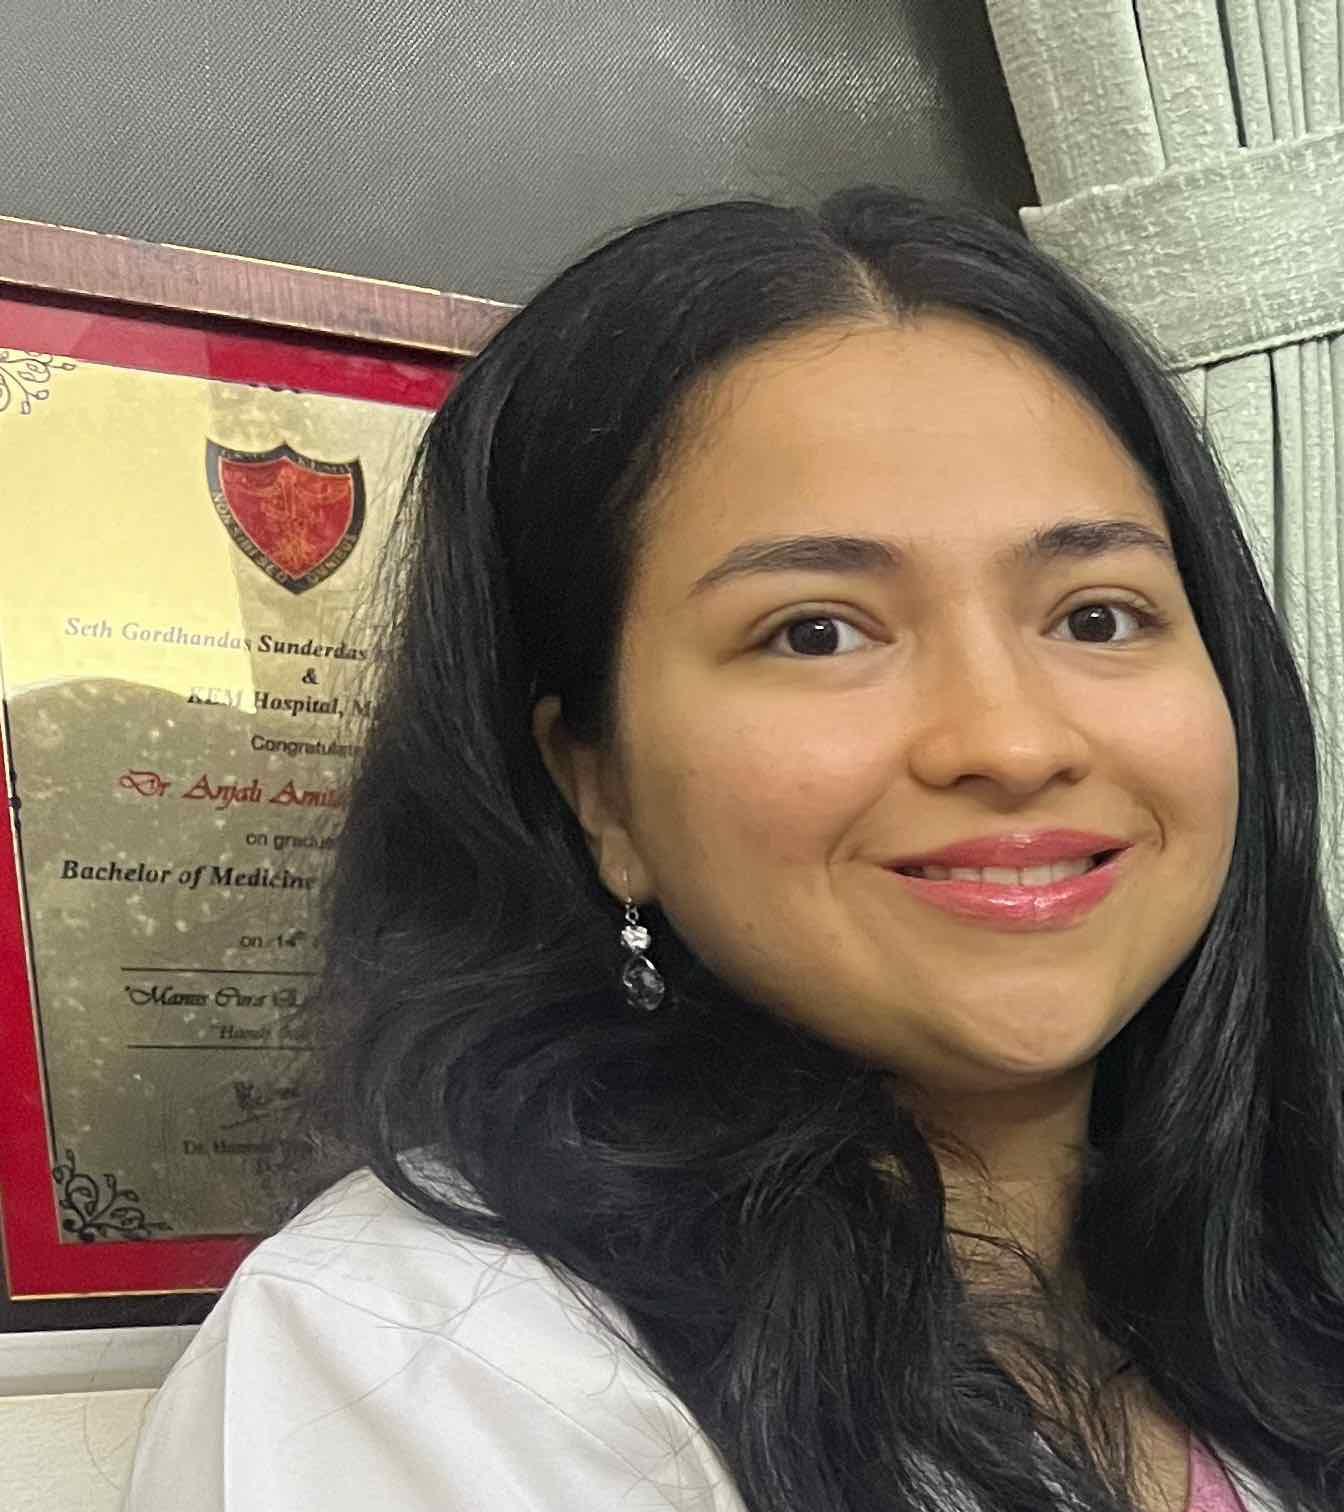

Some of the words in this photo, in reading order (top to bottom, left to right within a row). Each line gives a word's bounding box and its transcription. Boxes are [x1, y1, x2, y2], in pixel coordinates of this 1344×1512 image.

[64, 617, 113, 639] Seth
[122, 622, 251, 651] Gordhandas
[258, 634, 368, 661] Sunderdas
[302, 667, 319, 685] &
[254, 690, 344, 718] Hospital,
[118, 769, 170, 797] Dr
[182, 774, 262, 811] Anjali
[246, 832, 267, 846] on
[61, 860, 170, 884] Bachelor
[178, 865, 204, 890] of
[209, 866, 317, 890] Medicine
[240, 935, 263, 948] on
